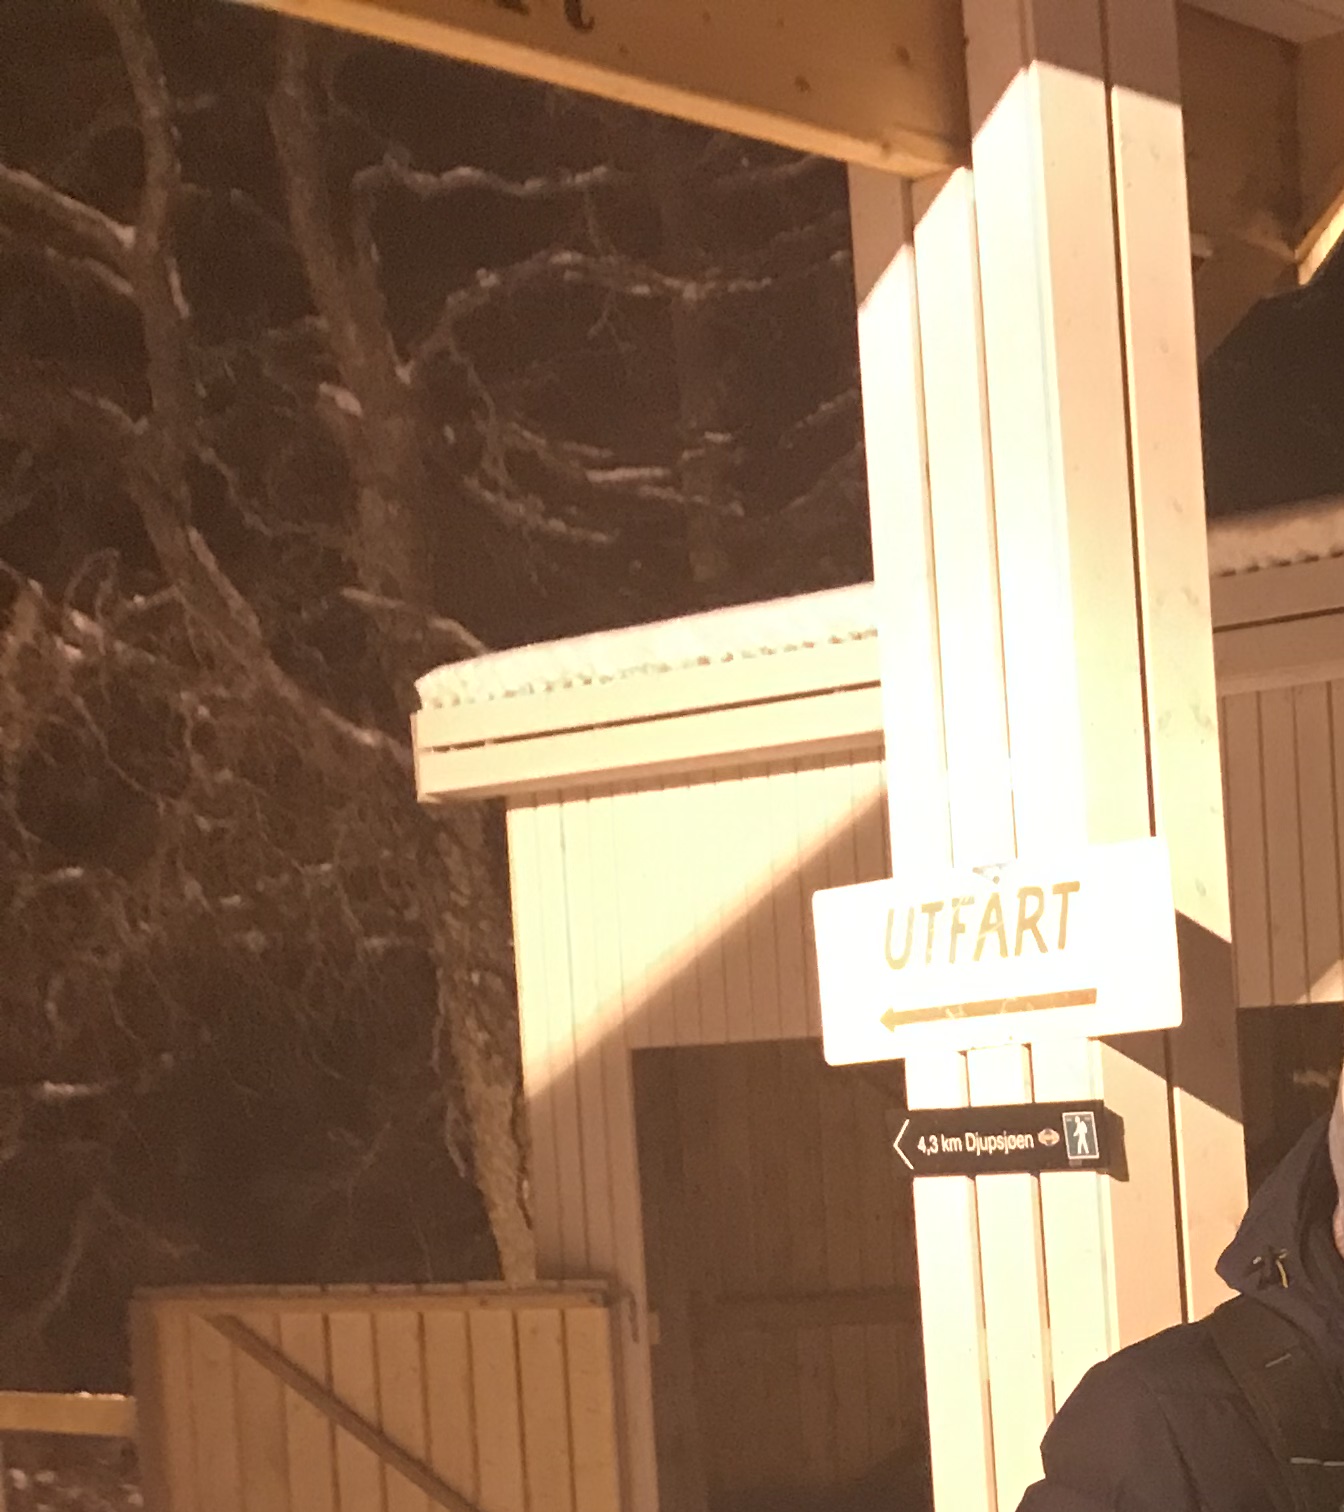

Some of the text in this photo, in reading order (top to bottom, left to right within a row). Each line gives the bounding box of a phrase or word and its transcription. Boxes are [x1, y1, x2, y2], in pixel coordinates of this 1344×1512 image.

[917, 1130, 1035, 1156] 4,3 km Djupsjøen
